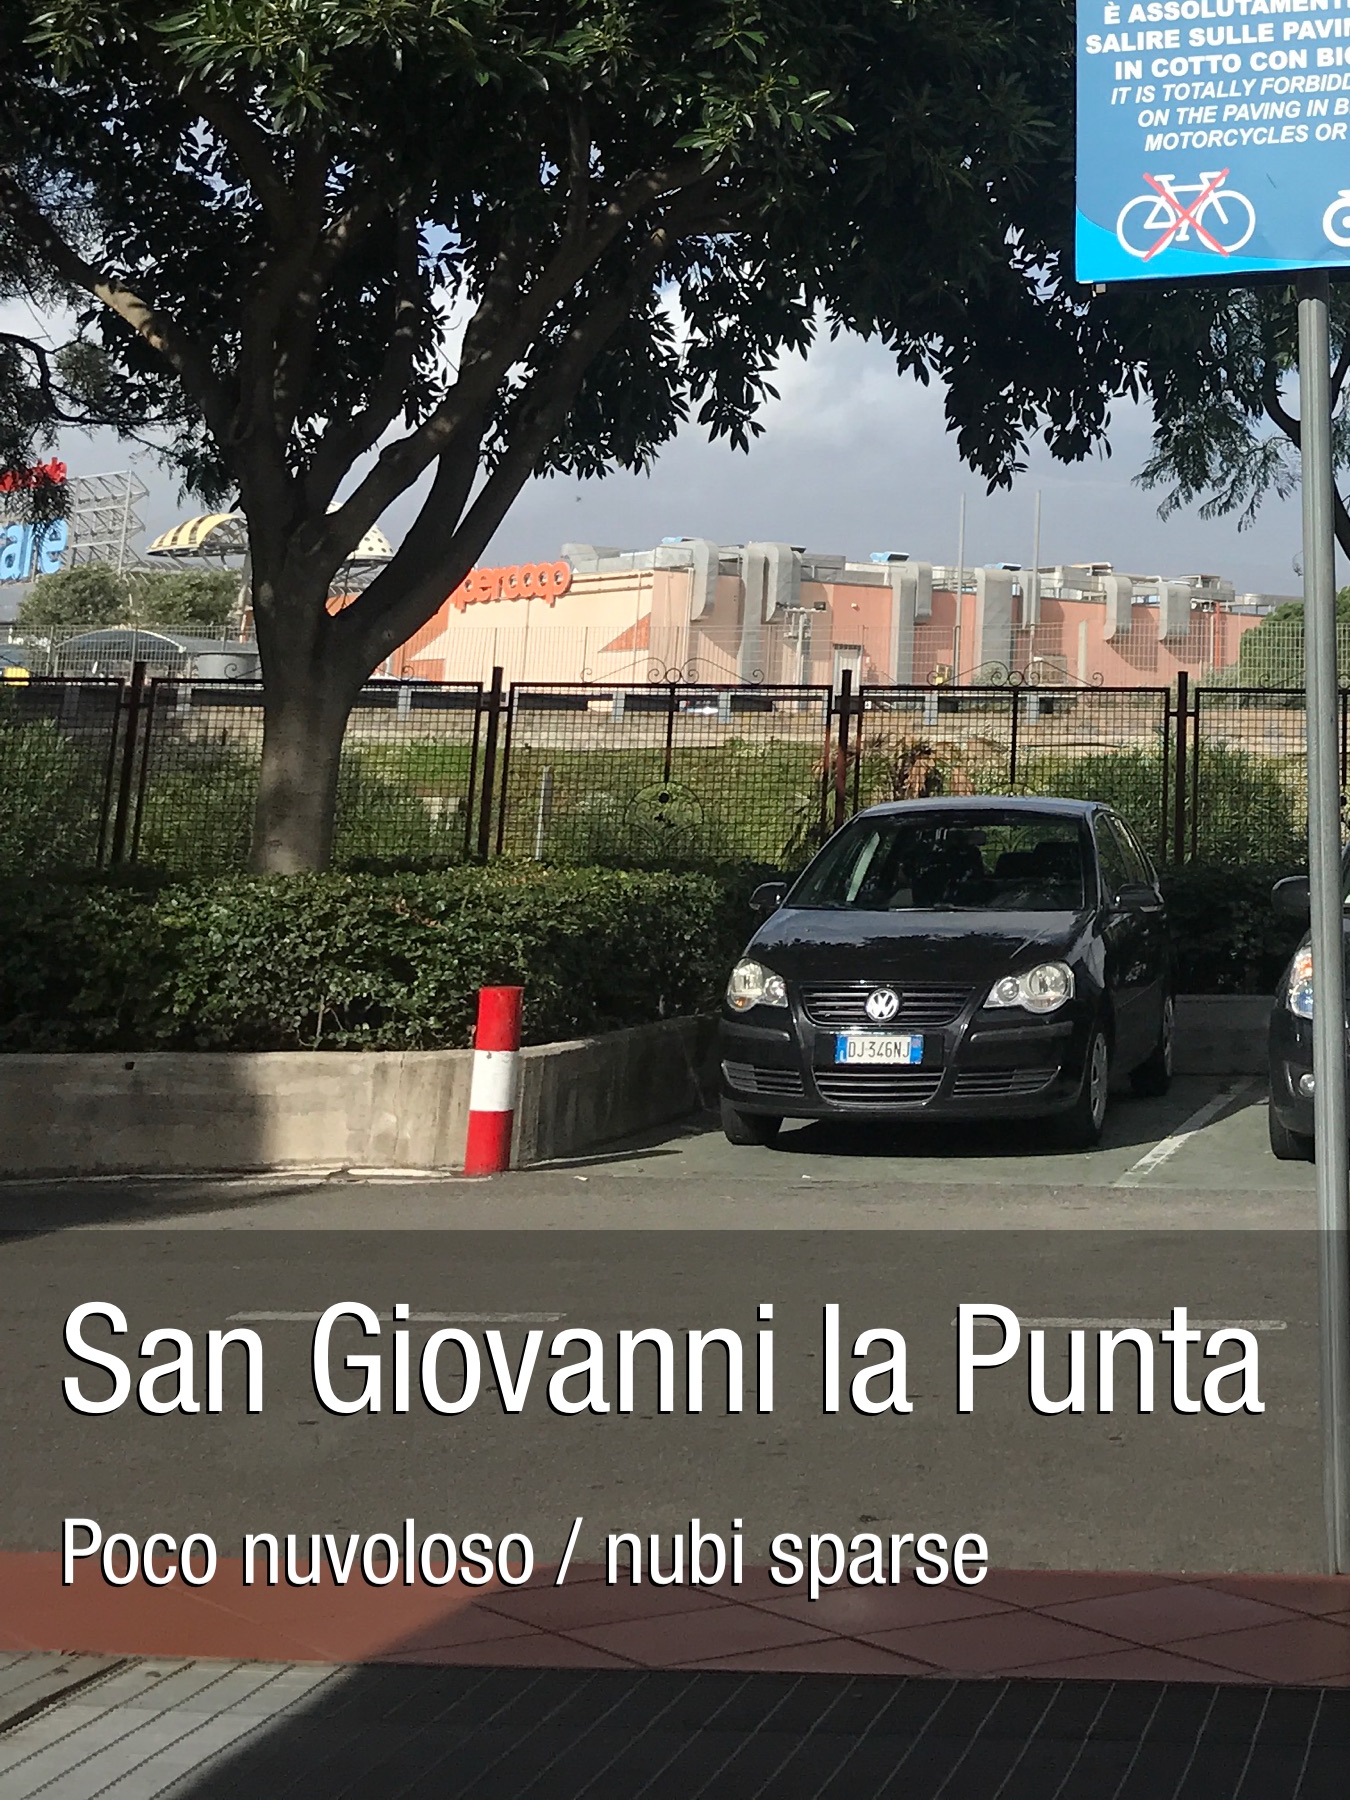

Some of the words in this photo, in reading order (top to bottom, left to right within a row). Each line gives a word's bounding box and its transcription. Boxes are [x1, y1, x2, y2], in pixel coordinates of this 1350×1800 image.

[1103, 1, 1121, 24] È
[1085, 28, 1181, 55] SALIRE
[1188, 23, 1275, 48] SULLE
[1114, 60, 1144, 80] IN
[1151, 53, 1242, 77] COTTO
[1249, 49, 1308, 72] CON
[1111, 86, 1133, 105] IT
[1135, 85, 1156, 103] IS
[1162, 79, 1257, 103] TOTALLY
[1137, 109, 1171, 128] ON
[1176, 105, 1218, 125] THE
[1222, 100, 1301, 122] PAVING
[1305, 98, 1330, 117] IN
[1144, 124, 1309, 152] MOTORCYCLES
[1315, 122, 1348, 142] OR
[0, 519, 68, 580] are
[451, 561, 571, 611] percoop
